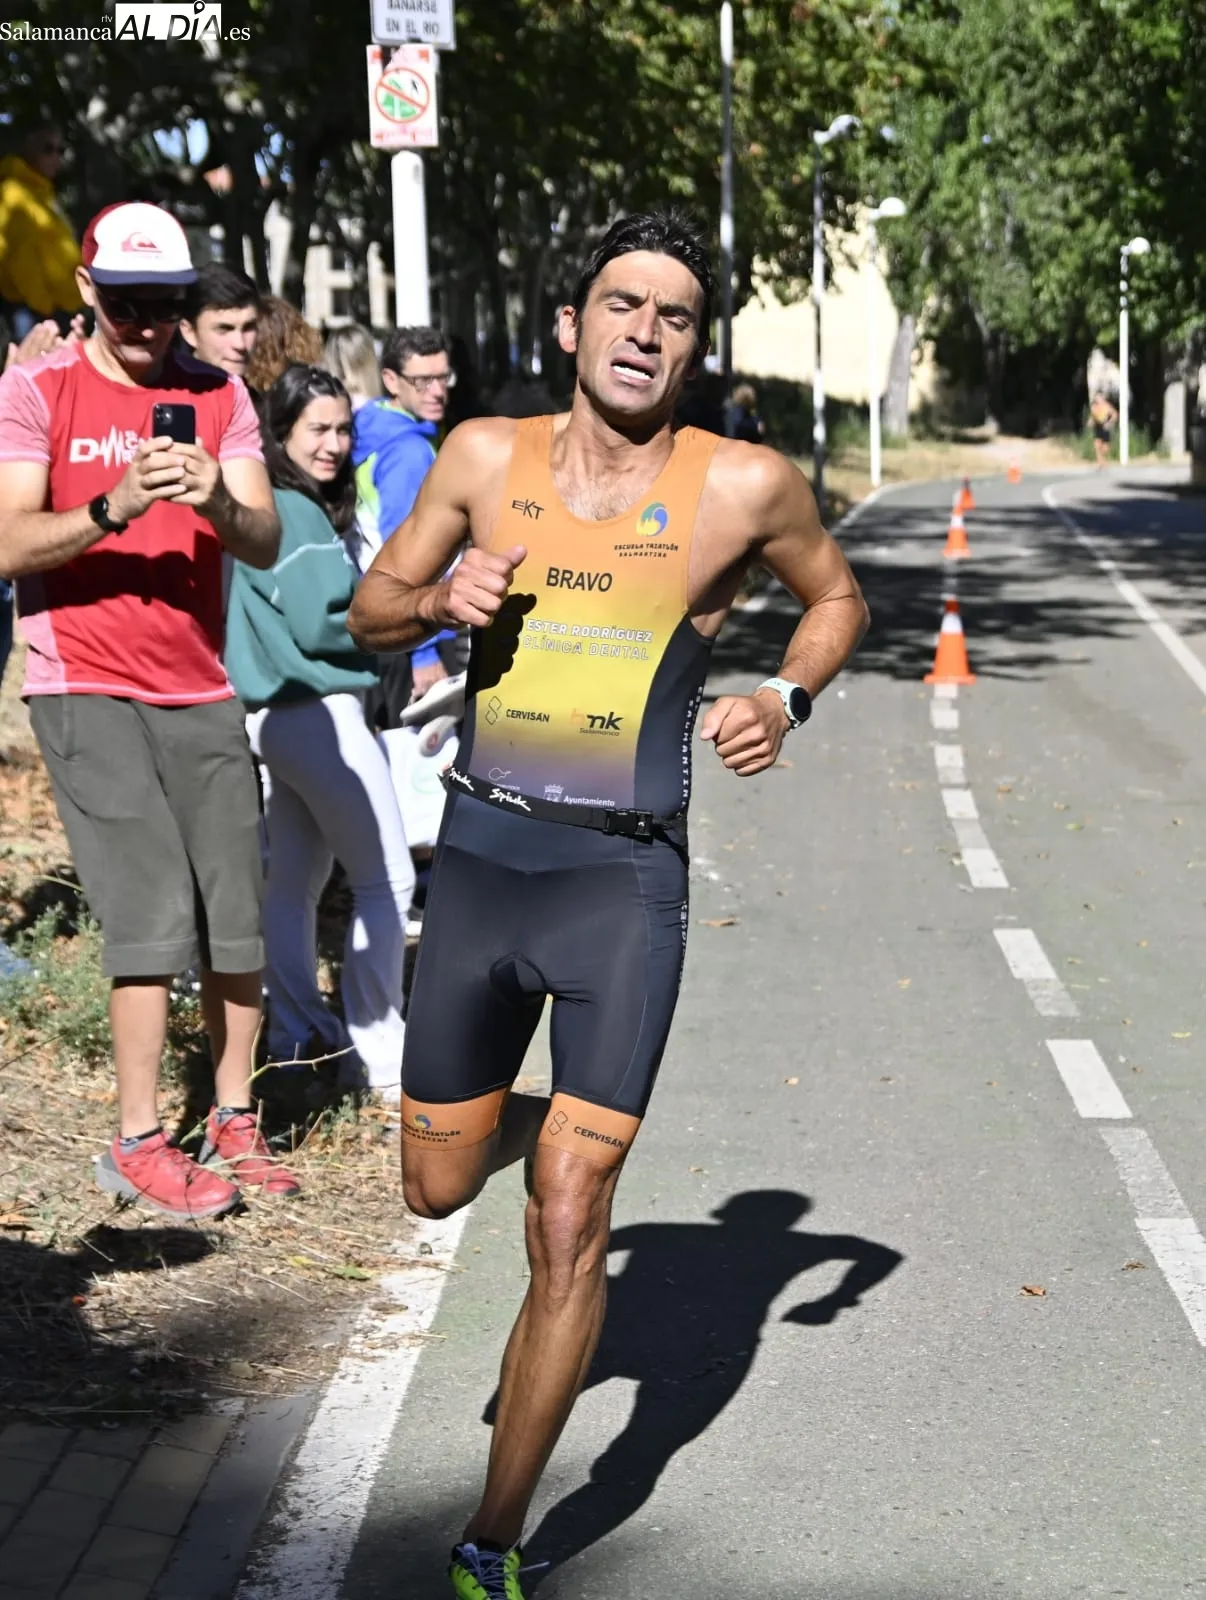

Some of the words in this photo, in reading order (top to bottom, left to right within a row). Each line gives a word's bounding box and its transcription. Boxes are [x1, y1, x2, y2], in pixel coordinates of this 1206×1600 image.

[385, 17, 400, 32] EN
[405, 19, 417, 34] EL
[511, 498, 544, 520] EKT
[614, 543, 644, 551] ESCUELA
[546, 566, 613, 593] BRAVO
[526, 619, 568, 636] ESTER
[571, 624, 654, 643] RODRÍGUEZ
[522, 634, 583, 655] CLÍNICA
[588, 642, 650, 661] DENTAL
[506, 709, 550, 723] CERVISÁN
[562, 794, 616, 807] Ayuntamiento
[573, 1125, 625, 1149] CERVISÁN
